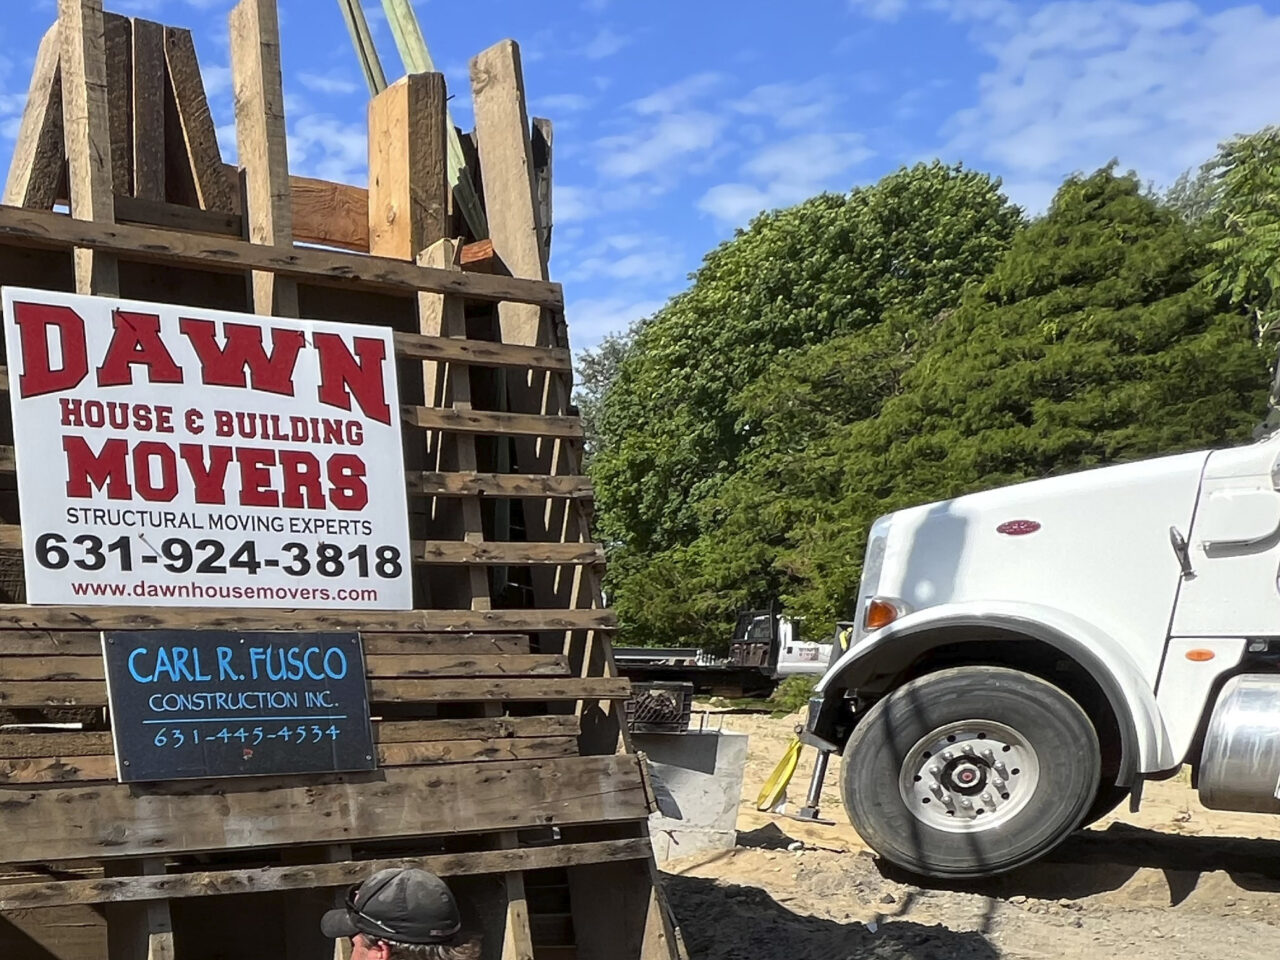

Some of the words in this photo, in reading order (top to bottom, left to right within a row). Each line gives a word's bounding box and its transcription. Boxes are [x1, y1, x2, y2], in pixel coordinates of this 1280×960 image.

[13, 300, 392, 426] DAWN
[59, 398, 175, 434] HOUSE
[185, 408, 205, 435] &
[214, 410, 364, 446] BUILDING
[62, 435, 369, 511] MOVERS
[67, 507, 204, 530] STRUCTURAL
[208, 513, 285, 532] MOVING
[289, 517, 372, 536] EXPERTS
[35, 532, 403, 579] 631-924-3818
[72, 580, 378, 602] www.dawnhousemovers.com
[127, 646, 212, 683] CARL
[217, 646, 245, 682] R.
[250, 645, 348, 681] FUSCO
[148, 691, 298, 712] CONSTRUCTION
[305, 690, 339, 708] INC.
[154, 724, 340, 748] 631-445-4534
